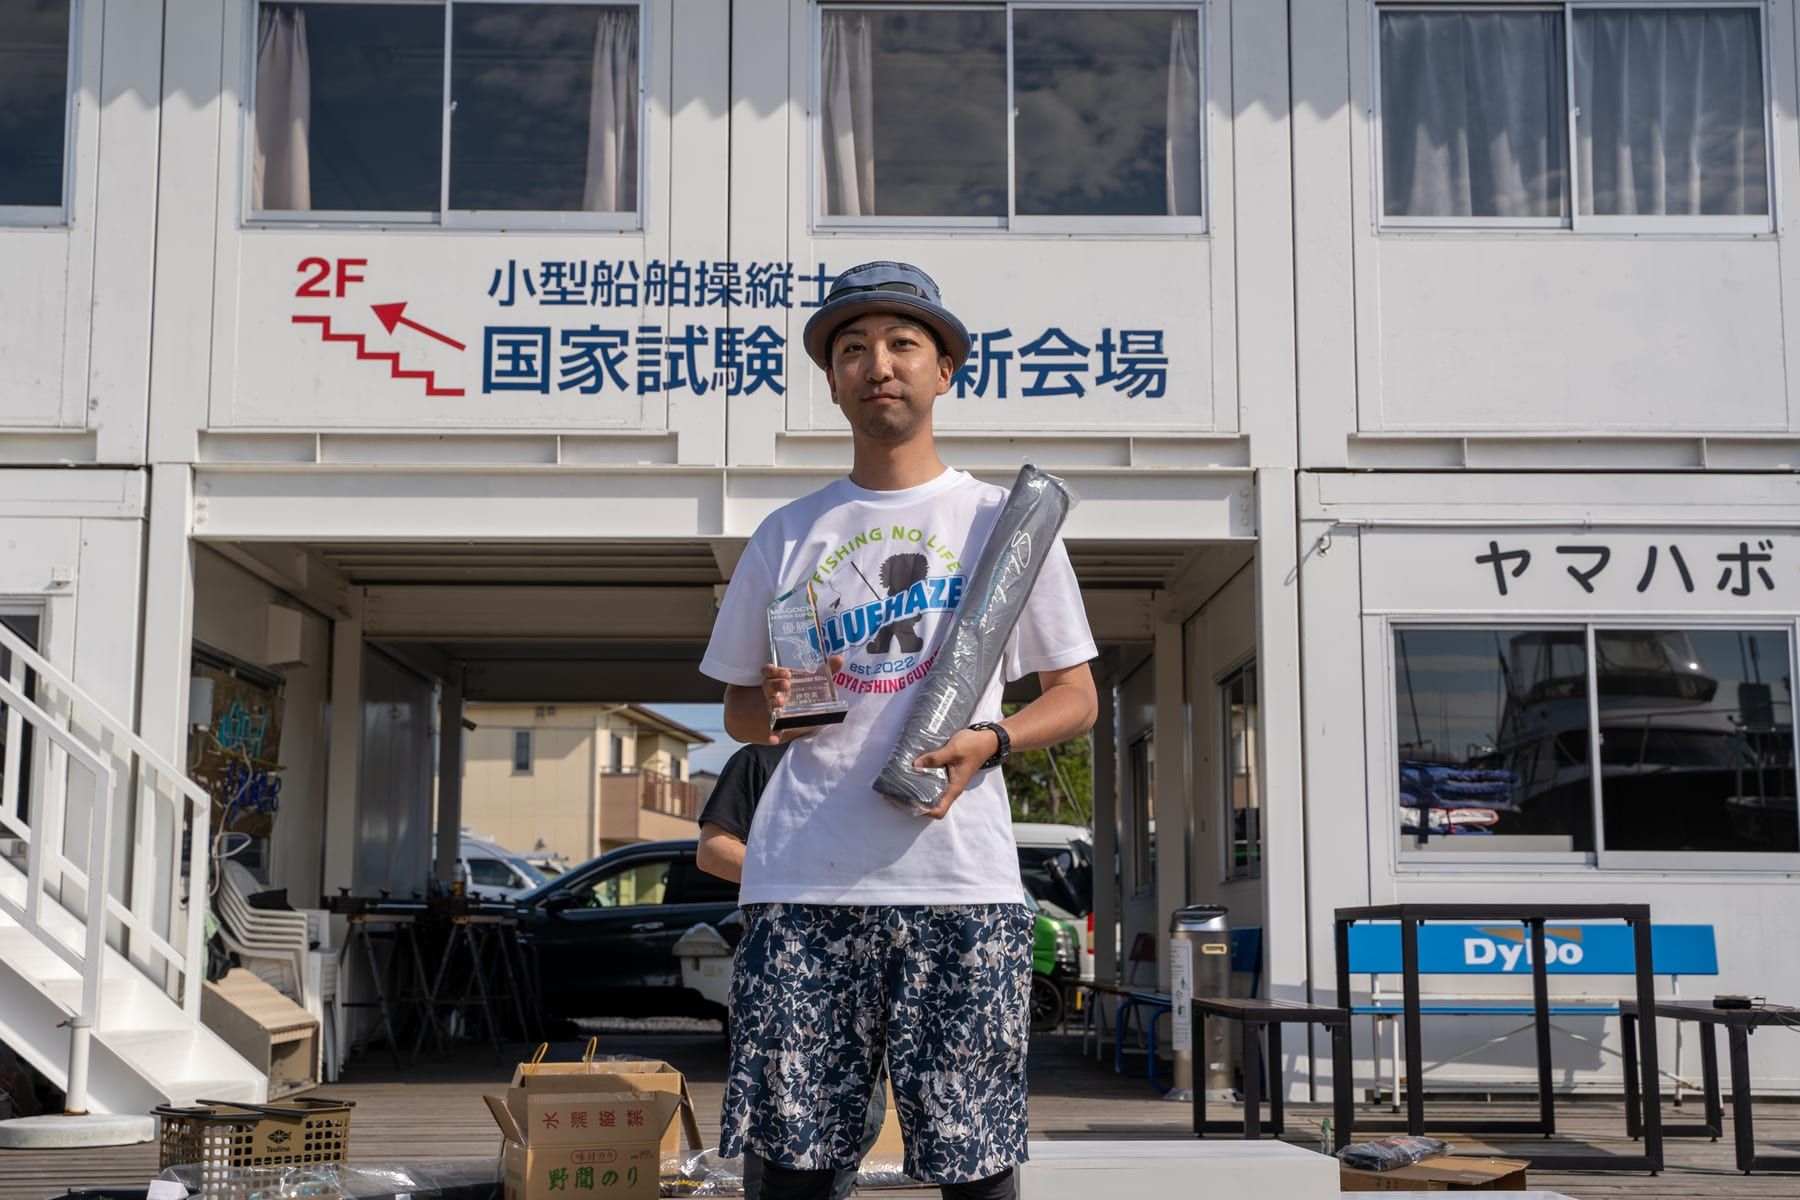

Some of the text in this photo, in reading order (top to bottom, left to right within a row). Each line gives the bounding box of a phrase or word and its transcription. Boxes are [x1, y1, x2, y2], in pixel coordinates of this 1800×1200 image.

[295, 256, 367, 297] 2F
[488, 260, 836, 308] 小型船舶操縦士
[482, 324, 1168, 399] 国家試験 新会場
[812, 527, 882, 585] FISHING
[892, 526, 922, 542] NO
[926, 535, 962, 572] LIFE
[1475, 539, 1775, 596] ヤマハボ
[807, 575, 966, 657] BLUEHAZE
[1464, 938, 1583, 971] DyDo
[548, 1166, 638, 1191] 野間のり
